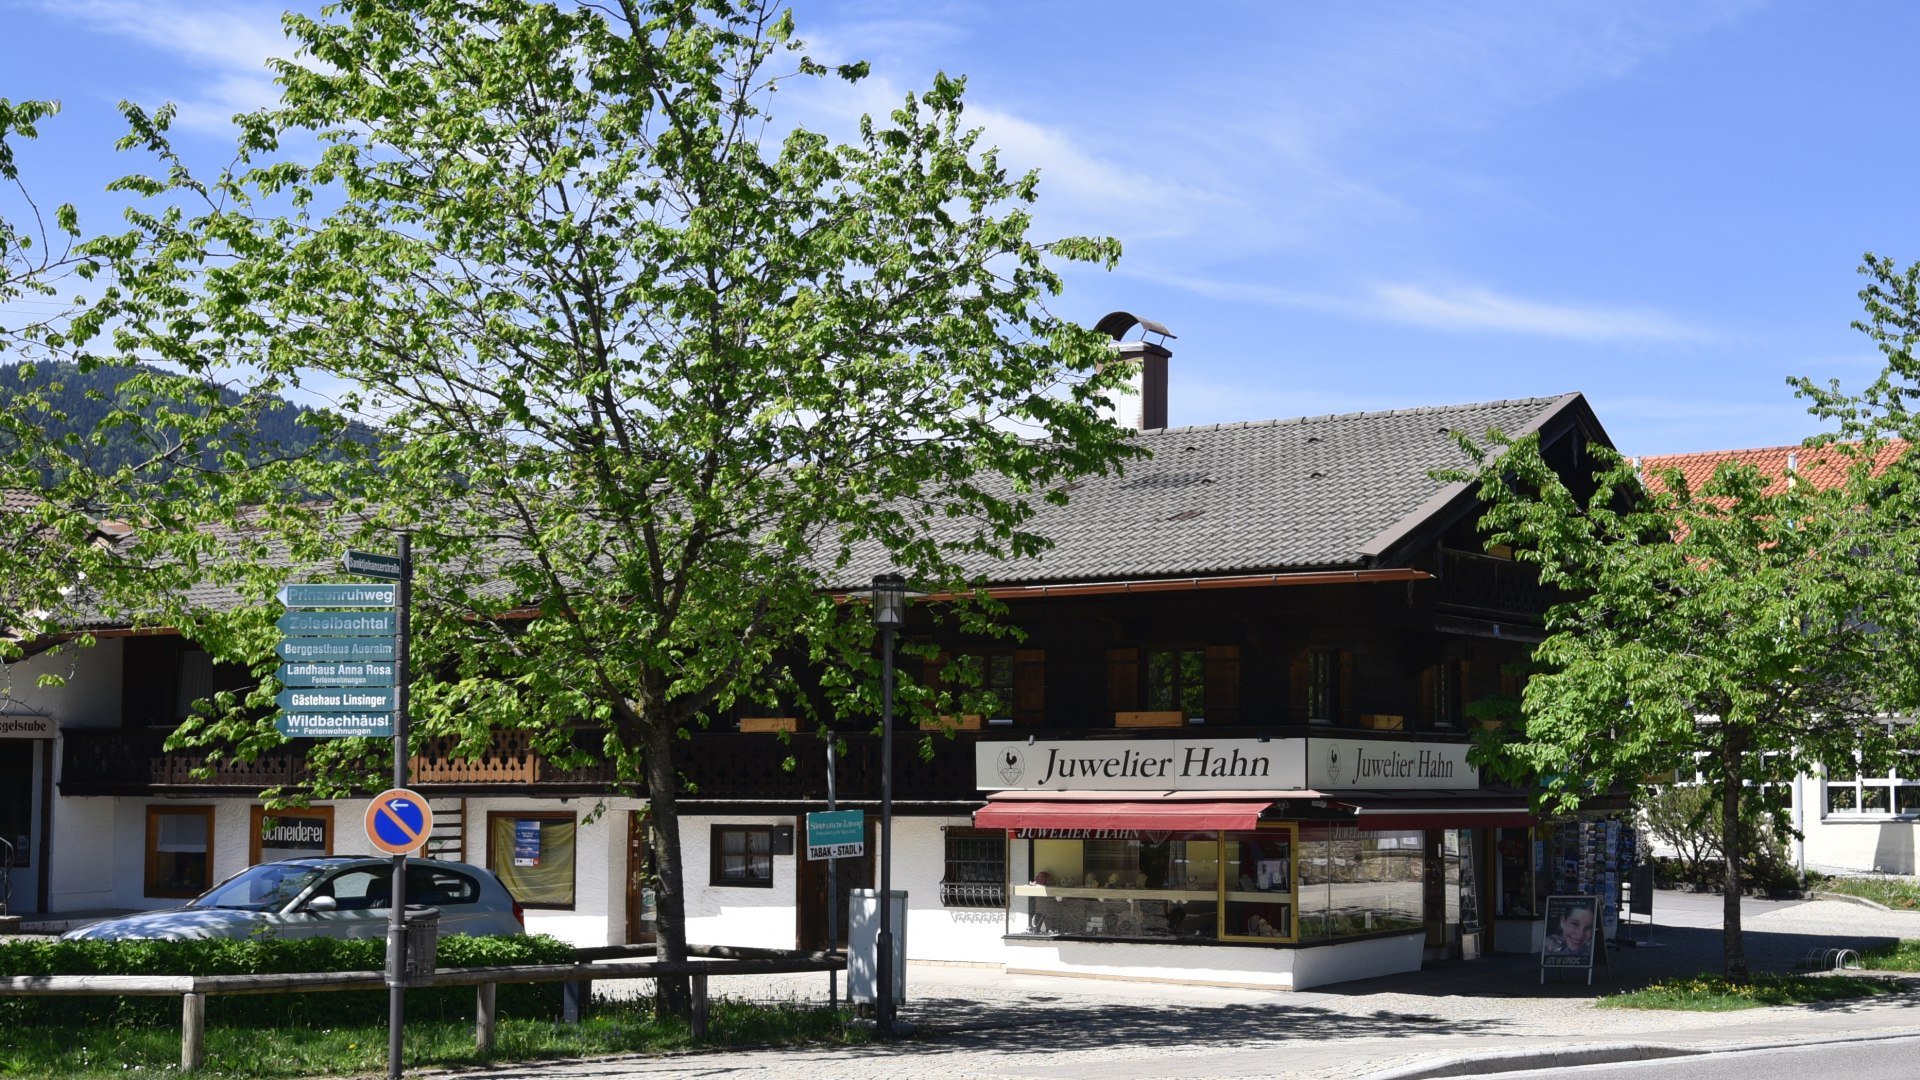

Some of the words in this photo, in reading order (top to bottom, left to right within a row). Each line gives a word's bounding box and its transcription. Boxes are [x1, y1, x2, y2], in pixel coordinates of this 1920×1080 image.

[289, 589, 393, 603] Prinzenruhweg
[290, 617, 388, 630] Zeiselbachtal
[285, 644, 350, 656] Berggasthaus
[352, 644, 392, 655] Aueralm
[287, 664, 336, 675] Landhaus
[338, 664, 364, 675] Anna
[366, 664, 391, 675] Rosa
[311, 676, 367, 685] Ferienwohnungen
[292, 694, 341, 706] Gästehaus
[343, 694, 387, 708] Linsinger
[0, 720, 47, 734] gelstube
[287, 714, 389, 727] Wildbachhäusl
[1038, 748, 1173, 785] Juwelier
[1179, 747, 1270, 777] Hahn
[1352, 748, 1414, 785] Juwelier
[1417, 750, 1453, 778] Hahn
[810, 846, 832, 858] TABAK
[838, 844, 857, 856] STADL
